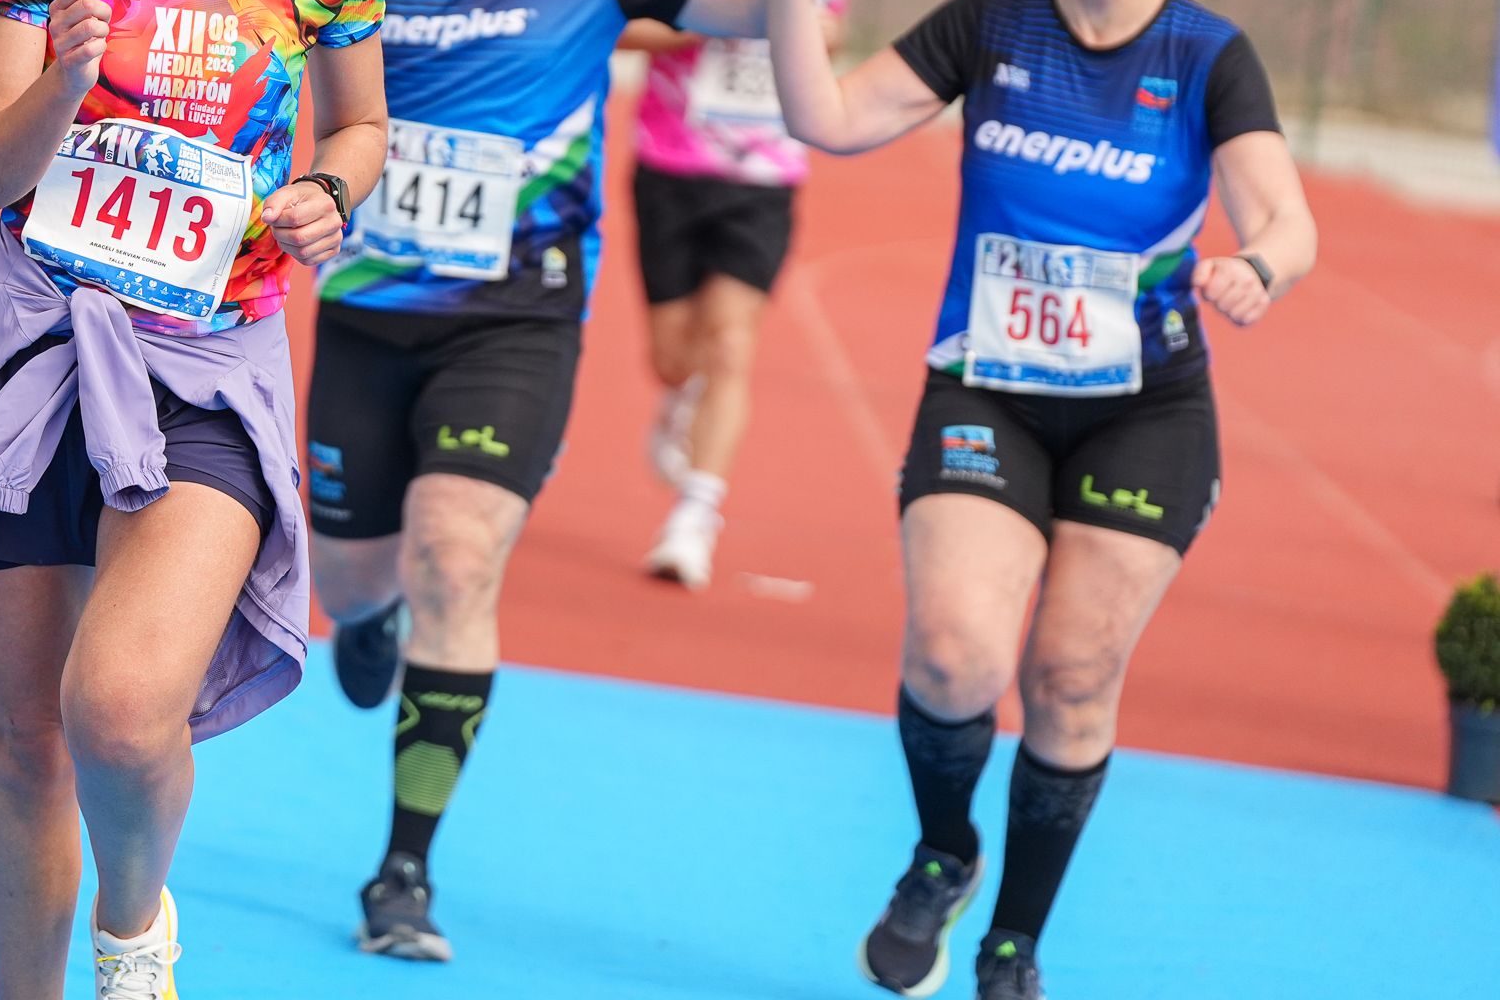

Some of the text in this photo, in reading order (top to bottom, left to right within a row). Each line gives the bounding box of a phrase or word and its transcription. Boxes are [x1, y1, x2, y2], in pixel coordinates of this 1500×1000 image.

[149, 6, 206, 54] XII
[207, 12, 239, 43] 08
[381, 7, 529, 51] nerplus
[206, 43, 237, 57] MARZO
[146, 51, 203, 78] MEDIA
[205, 56, 235, 73] 2026
[143, 75, 232, 104] MARATÓN
[139, 98, 187, 120] & 10K
[187, 110, 224, 125] LUCENA
[189, 102, 226, 115] Ciudad de
[74, 124, 144, 169] 21K
[974, 119, 1156, 184] enerplus
[174, 166, 200, 184] 2026
[380, 167, 484, 228] 1414
[70, 167, 214, 262] 1413
[90, 241, 167, 268] ARACELI SERVIAN CORDON
[109, 257, 125, 265] TALLA
[1007, 287, 1094, 348] 564
